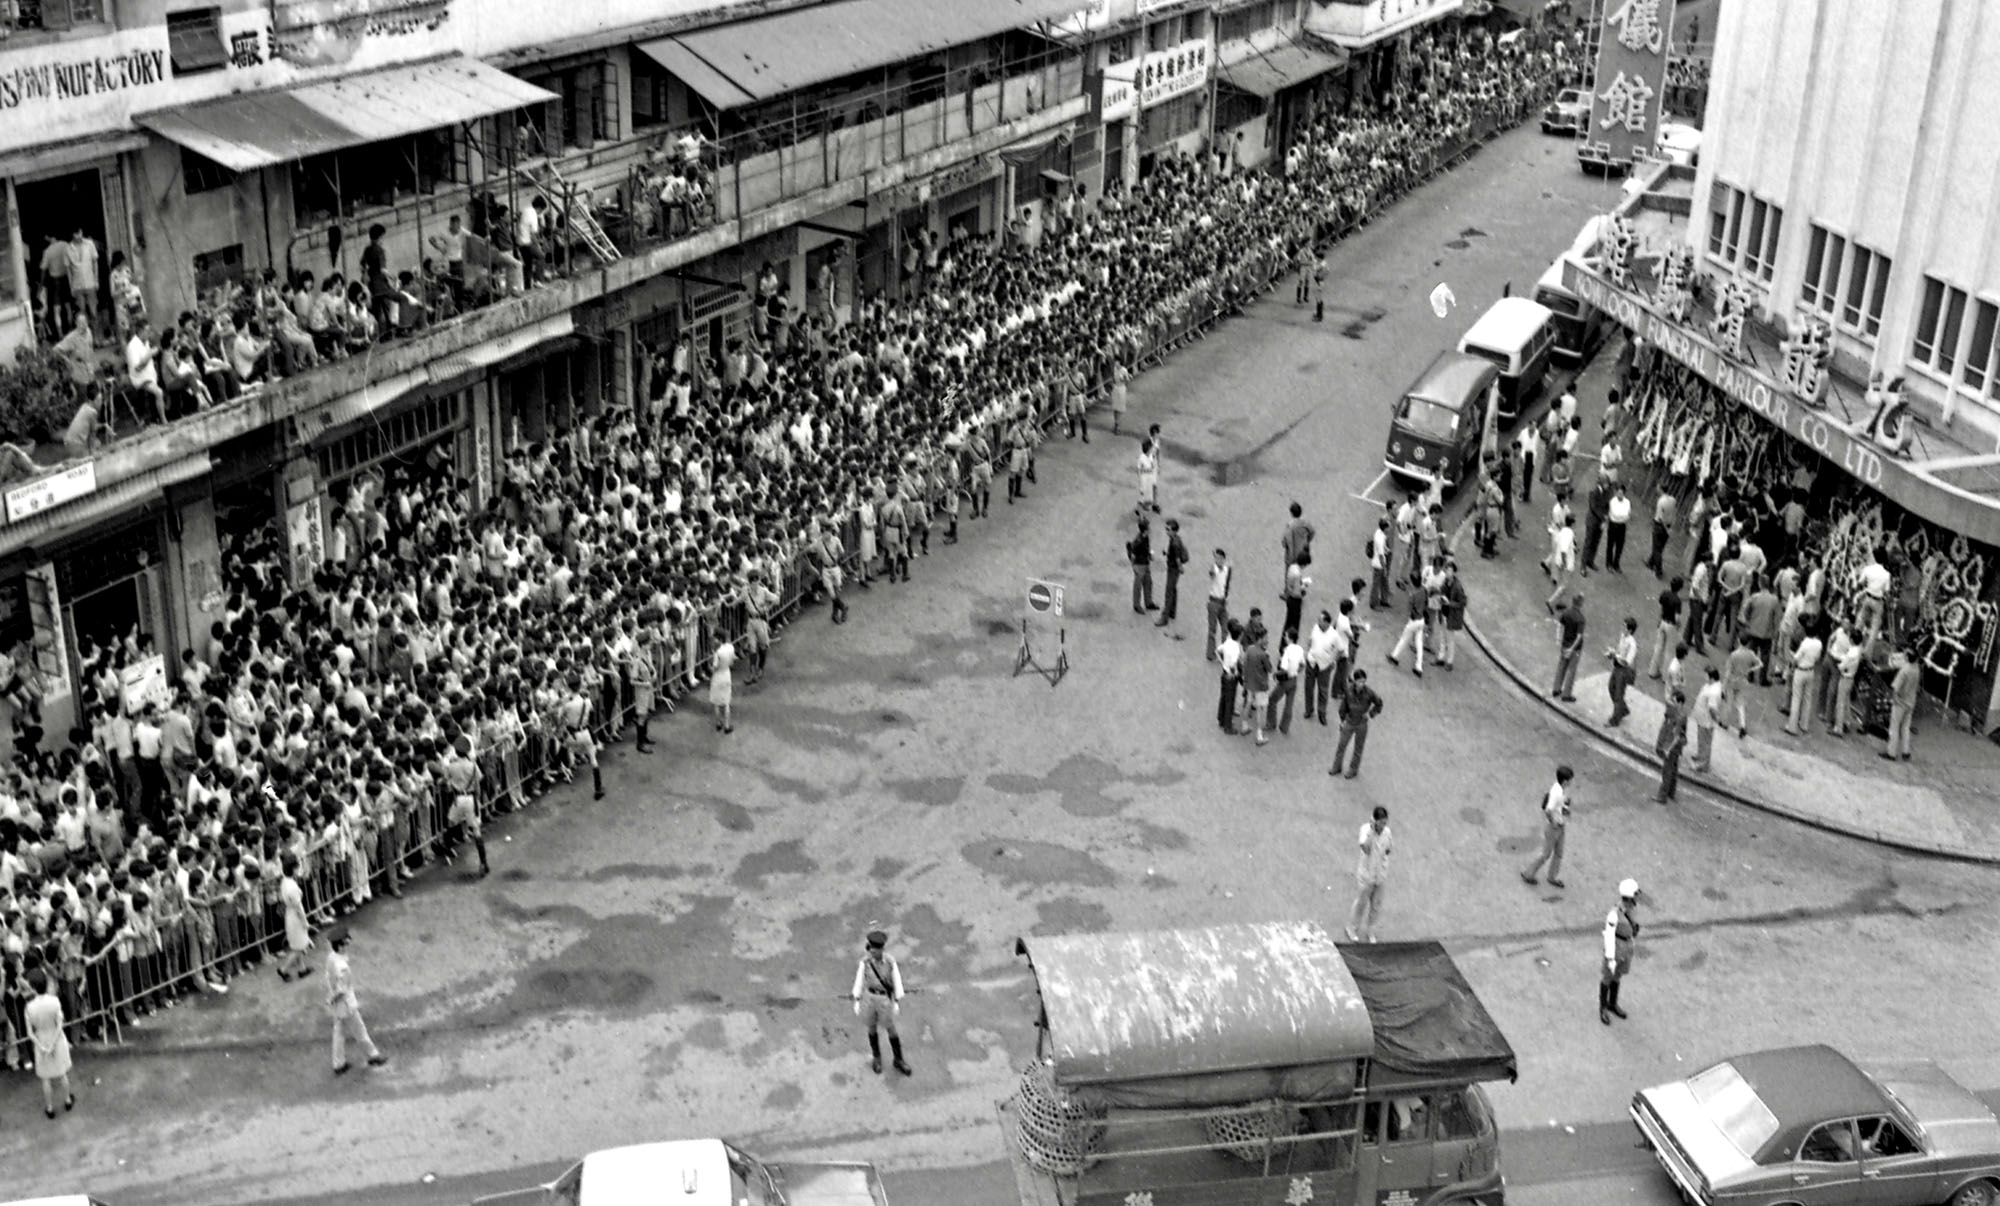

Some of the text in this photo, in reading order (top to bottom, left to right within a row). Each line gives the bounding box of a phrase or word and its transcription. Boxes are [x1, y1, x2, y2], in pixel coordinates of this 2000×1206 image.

[1574, 274, 1642, 332] KOWLOON
[1647, 315, 1706, 375] FUNERAL
[1715, 360, 1789, 428] PARLOUR
